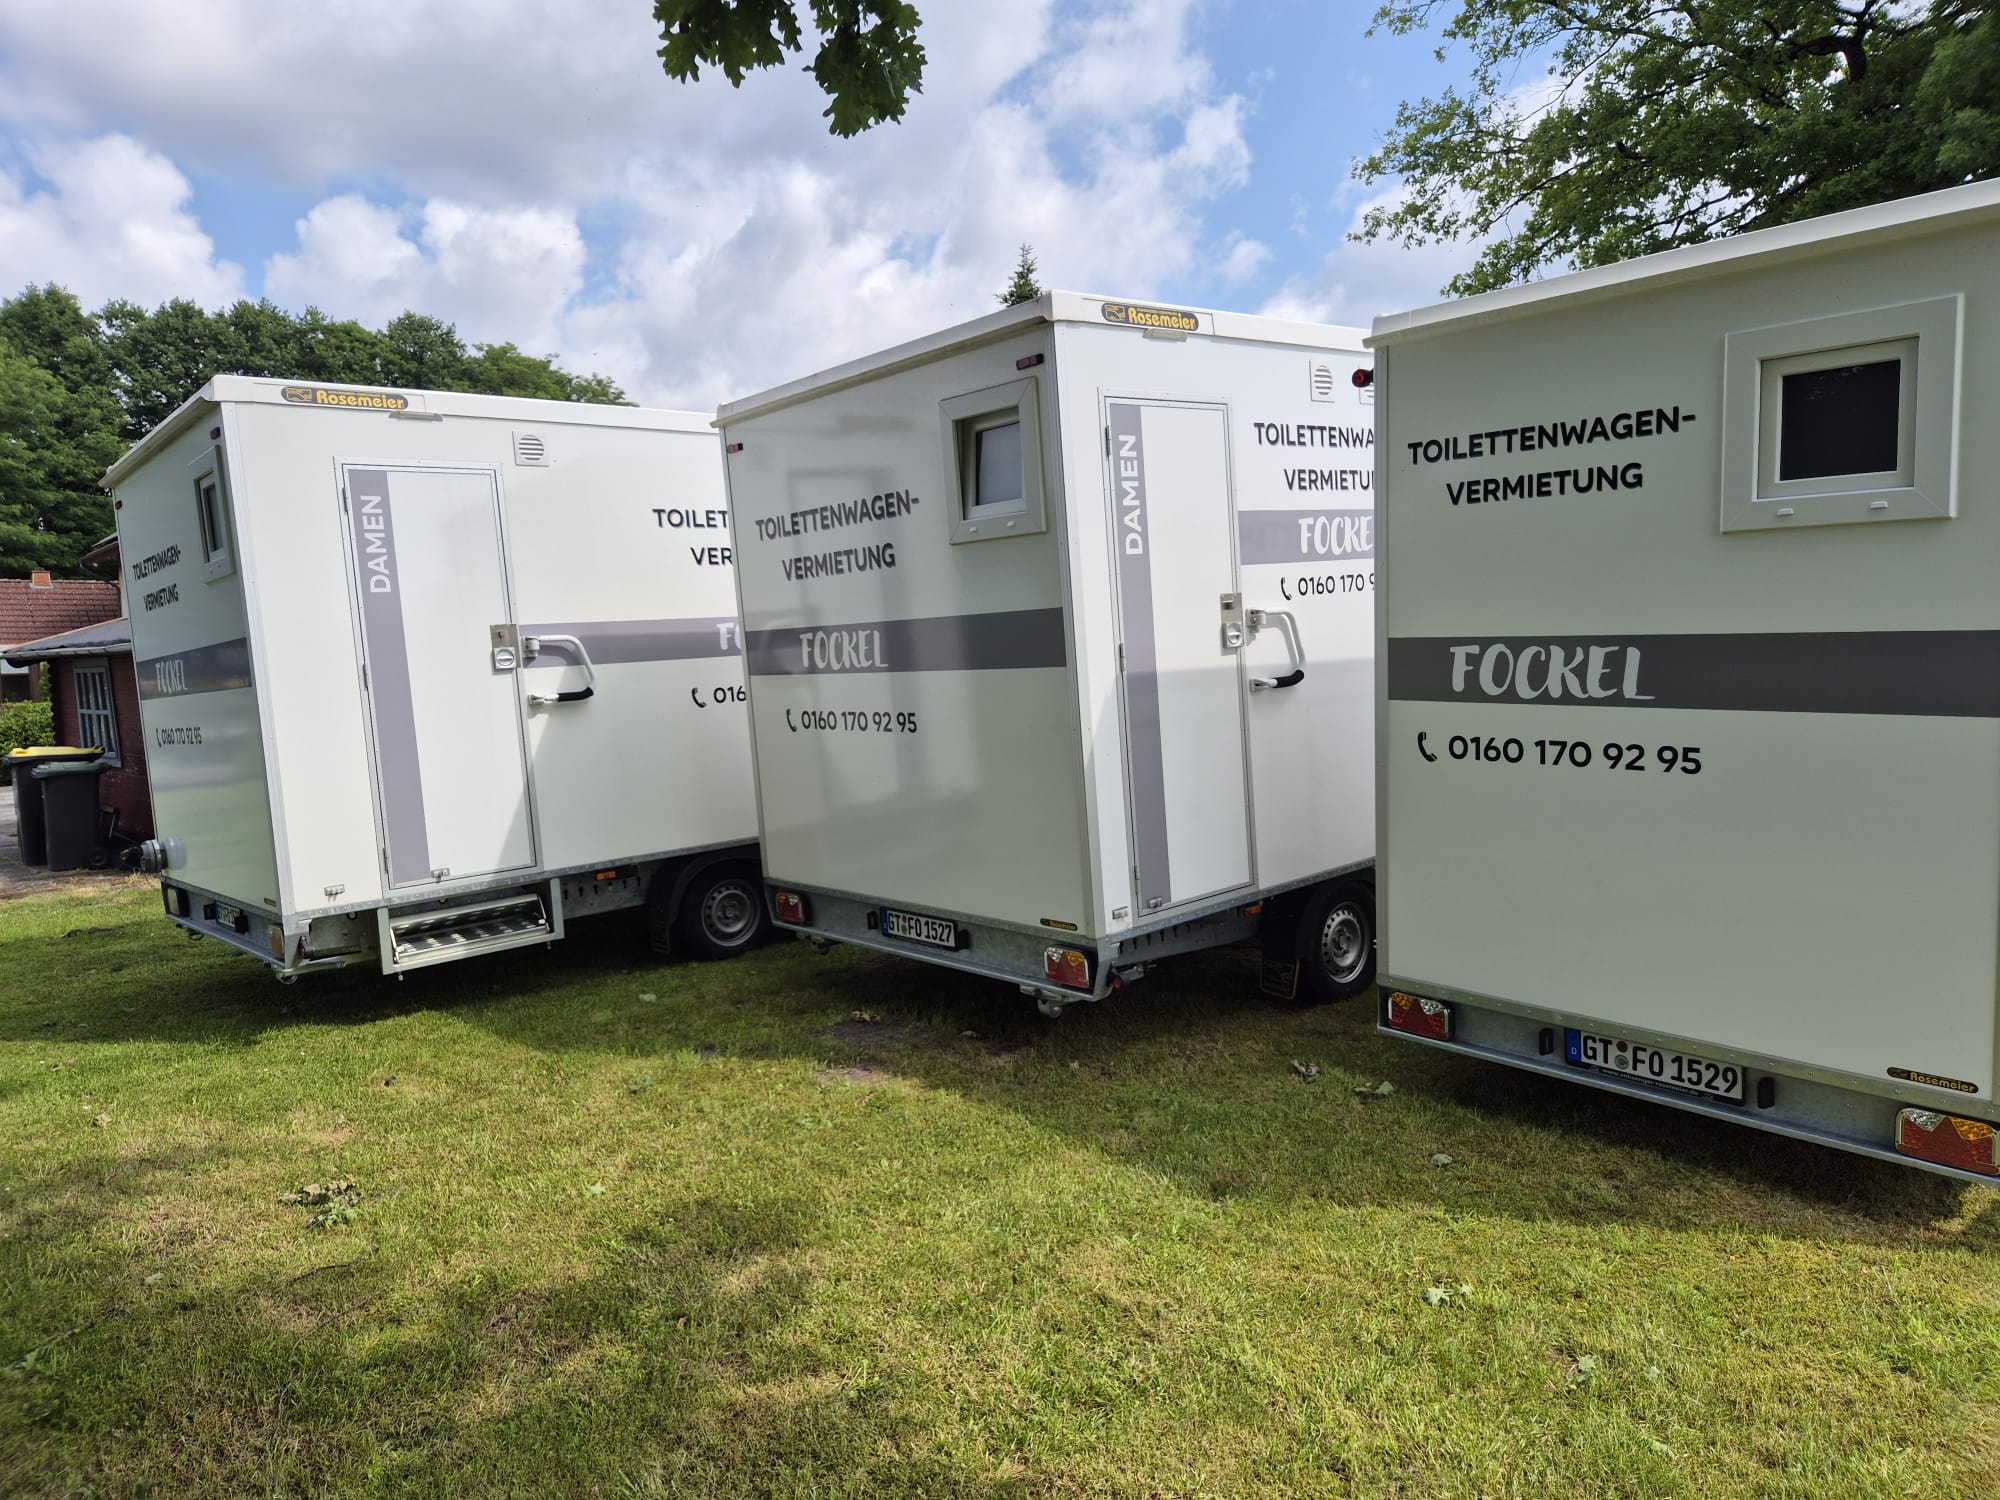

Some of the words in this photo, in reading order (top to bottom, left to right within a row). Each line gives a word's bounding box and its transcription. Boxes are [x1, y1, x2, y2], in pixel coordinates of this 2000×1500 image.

[1128, 307, 1195, 330] Rosemeier
[316, 389, 404, 409] Rosemeier
[1408, 406, 1696, 465] TOILETTENWAGEN-
[1119, 435, 1144, 555] DAMEN
[1283, 468, 1374, 491] VERMIETU
[1446, 462, 1643, 505] VERMIETUNG
[755, 489, 920, 541] TOILETTENWAGEN-
[133, 544, 181, 581] TOILETTENWAGEN-
[360, 495, 391, 593] DAMEN
[782, 542, 896, 581] VERMIETUNG
[144, 583, 179, 612] VERMIETUNG
[1298, 575, 1335, 596] 0160
[1340, 573, 1365, 593] 170
[800, 630, 889, 671] FOCKEL
[155, 659, 188, 694] FOCKEL
[1450, 643, 1655, 700] FOCKEL
[161, 728, 175, 744] 0160
[175, 728, 185, 744] 170
[186, 727, 194, 744] 92
[194, 727, 202, 744] 95
[801, 710, 837, 731] 0160
[841, 711, 868, 732] 170
[873, 711, 893, 732] 92
[896, 712, 918, 733] 95
[1448, 735, 1524, 763] 0160
[1534, 739, 1592, 767] 170
[1603, 743, 1645, 771] 92
[1657, 746, 1702, 775] 95
[888, 912, 901, 932] GT
[907, 917, 922, 937] FO
[924, 920, 952, 943] 1527
[1582, 1035, 1613, 1064] GT
[1632, 1045, 1664, 1077] FO
[1670, 1055, 1738, 1093] 1529
[1910, 1072, 1975, 1093] Rosemeier
